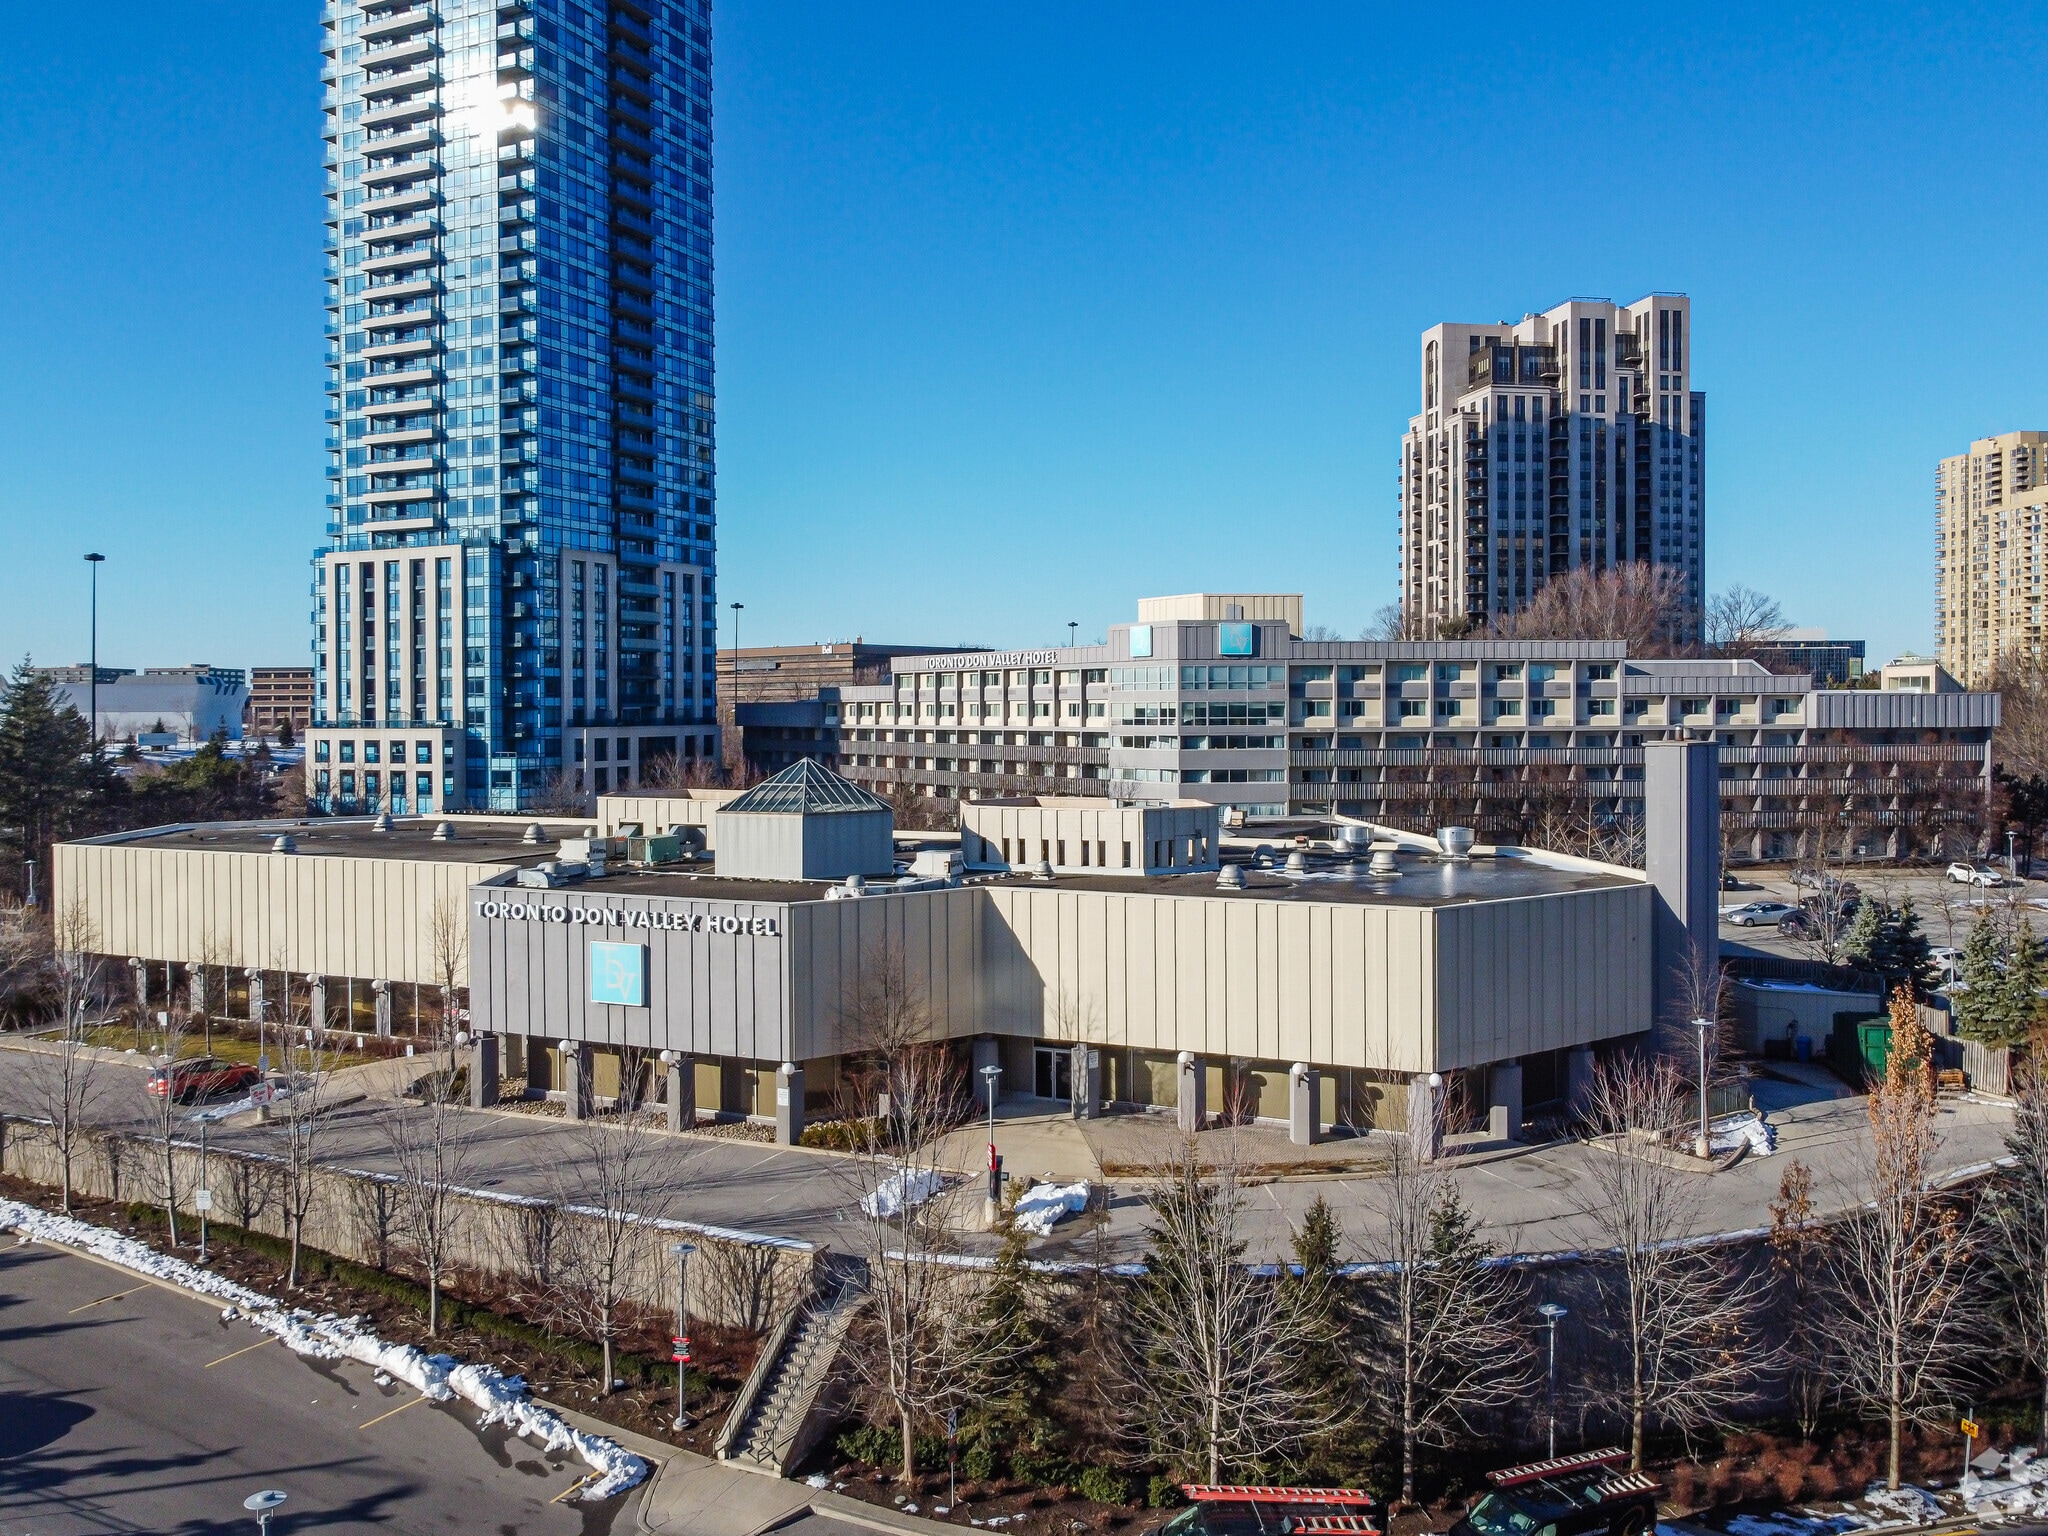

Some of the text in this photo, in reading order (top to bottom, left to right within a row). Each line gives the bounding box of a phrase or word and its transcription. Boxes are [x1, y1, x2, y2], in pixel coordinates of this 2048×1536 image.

[925, 651, 1058, 669] TORONTO DON VALLEY HOTEL
[474, 900, 776, 936] TORONTO DON VALLEY HOTEL
